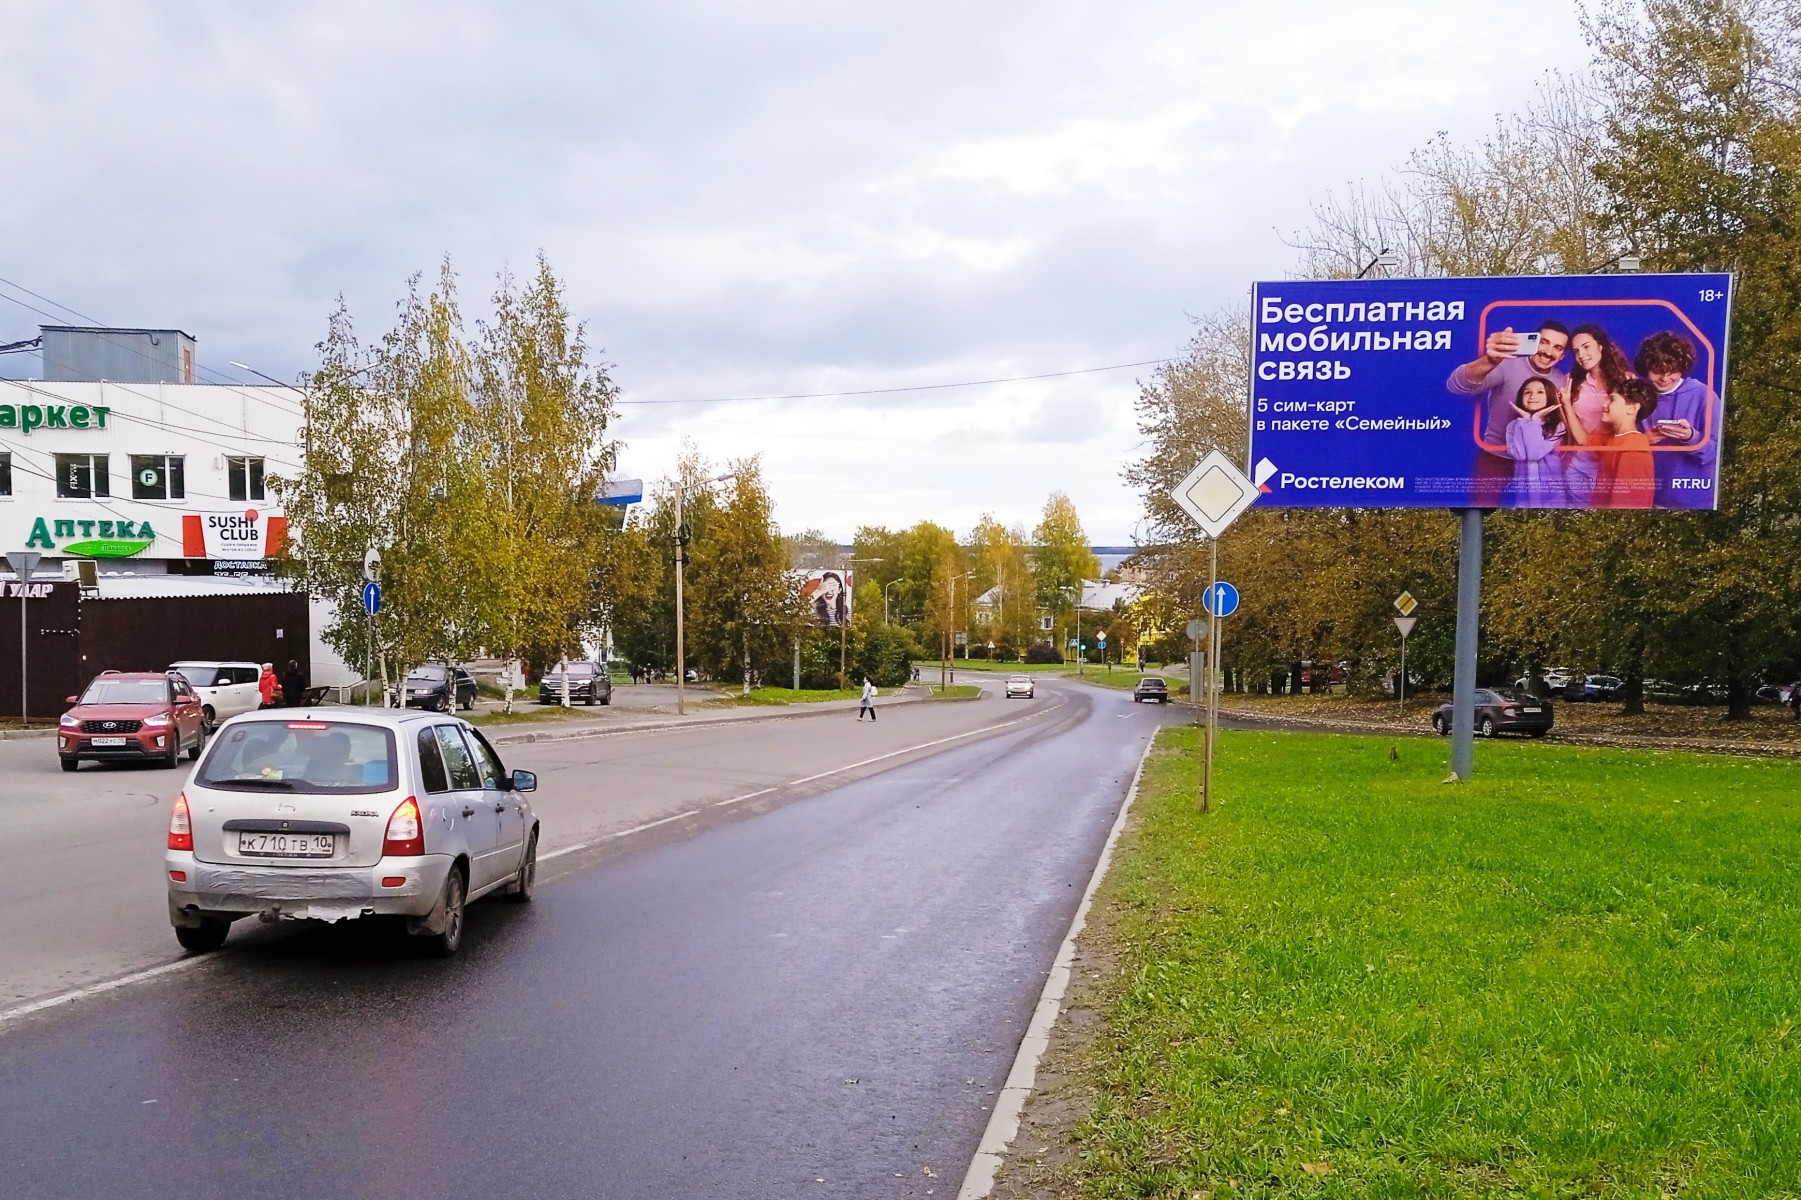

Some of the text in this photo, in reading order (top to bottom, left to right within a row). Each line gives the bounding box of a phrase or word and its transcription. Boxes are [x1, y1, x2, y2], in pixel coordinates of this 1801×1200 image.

[1698, 289, 1724, 302] 18+
[1261, 296, 1465, 324] Бесплатная
[1259, 324, 1452, 352] мобильная
[1257, 360, 1351, 380] связь
[1256, 397, 1356, 415] 5 сим-карт
[1256, 415, 1452, 431] в пакете «Семейный»
[145, 472, 153, 483] F
[1280, 472, 1405, 490] Ростелеком
[1671, 478, 1712, 490] RT.RU
[208, 516, 254, 528] SUSHI
[220, 529, 259, 541] CLUB
[213, 560, 268, 570] ДОСТАВКА
[313, 836, 328, 848] 10
